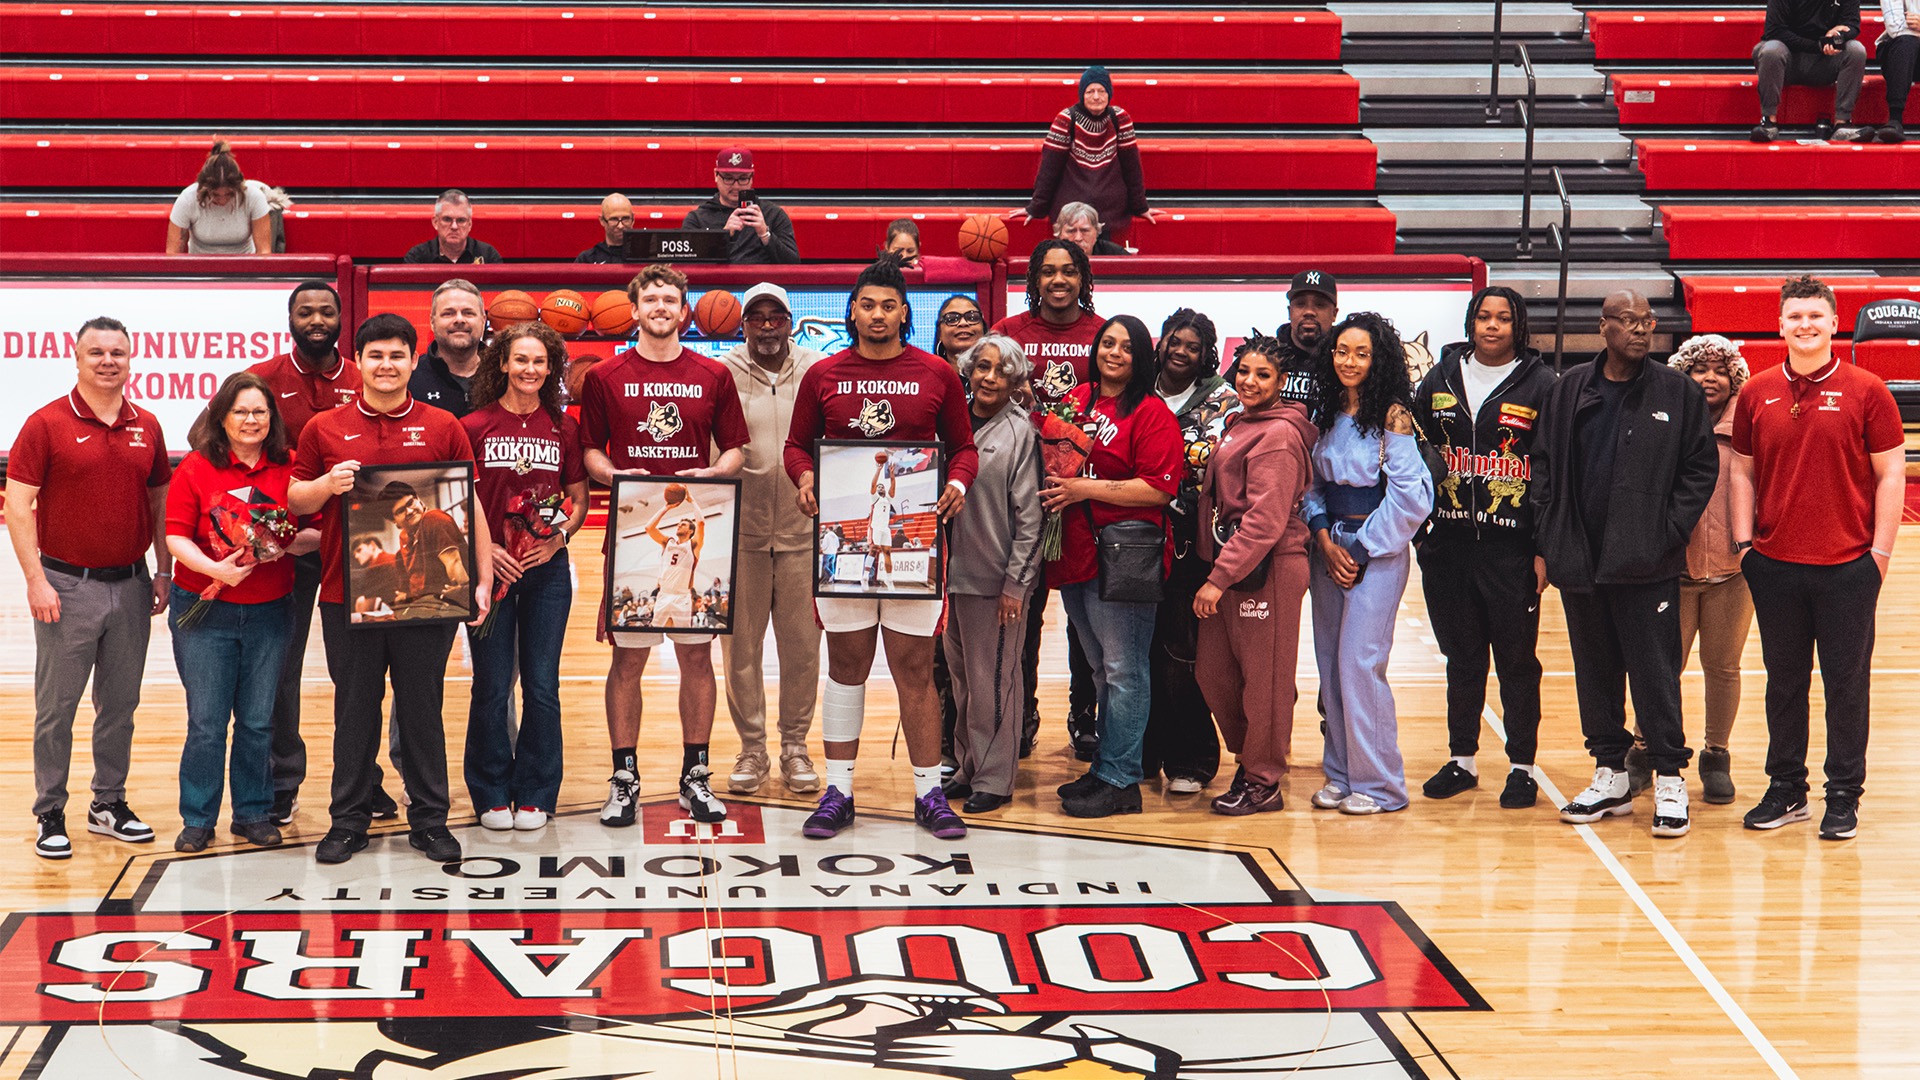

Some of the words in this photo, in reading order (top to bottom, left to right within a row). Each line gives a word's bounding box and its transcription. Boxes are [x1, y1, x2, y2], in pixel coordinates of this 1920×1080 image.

[661, 240, 693, 253] POSS.
[1306, 271, 1321, 285] NY
[3, 331, 78, 359] DIAN
[1024, 343, 1039, 357] IU
[1041, 343, 1093, 358] KOKOM
[124, 372, 218, 400] KOMO
[624, 383, 640, 397] IU
[643, 382, 703, 398] KOKOMO
[837, 381, 852, 394] IU
[856, 380, 920, 395] KOKOMO
[517, 437, 560, 447] UNIVERSITY
[485, 443, 560, 464] KOKOMO
[627, 446, 699, 459] BASKETBALL
[1441, 446, 1531, 481] bliminal
[1437, 507, 1470, 520] Produc
[1492, 514, 1517, 528] Love
[670, 553, 679, 566] 5
[879, 560, 915, 572] CGARS
[441, 852, 975, 879] KOKOMO
[264, 885, 768, 901] UNIVERSITY
[809, 881, 1152, 897] INDIANA
[38, 921, 1382, 1003] COUGARS
